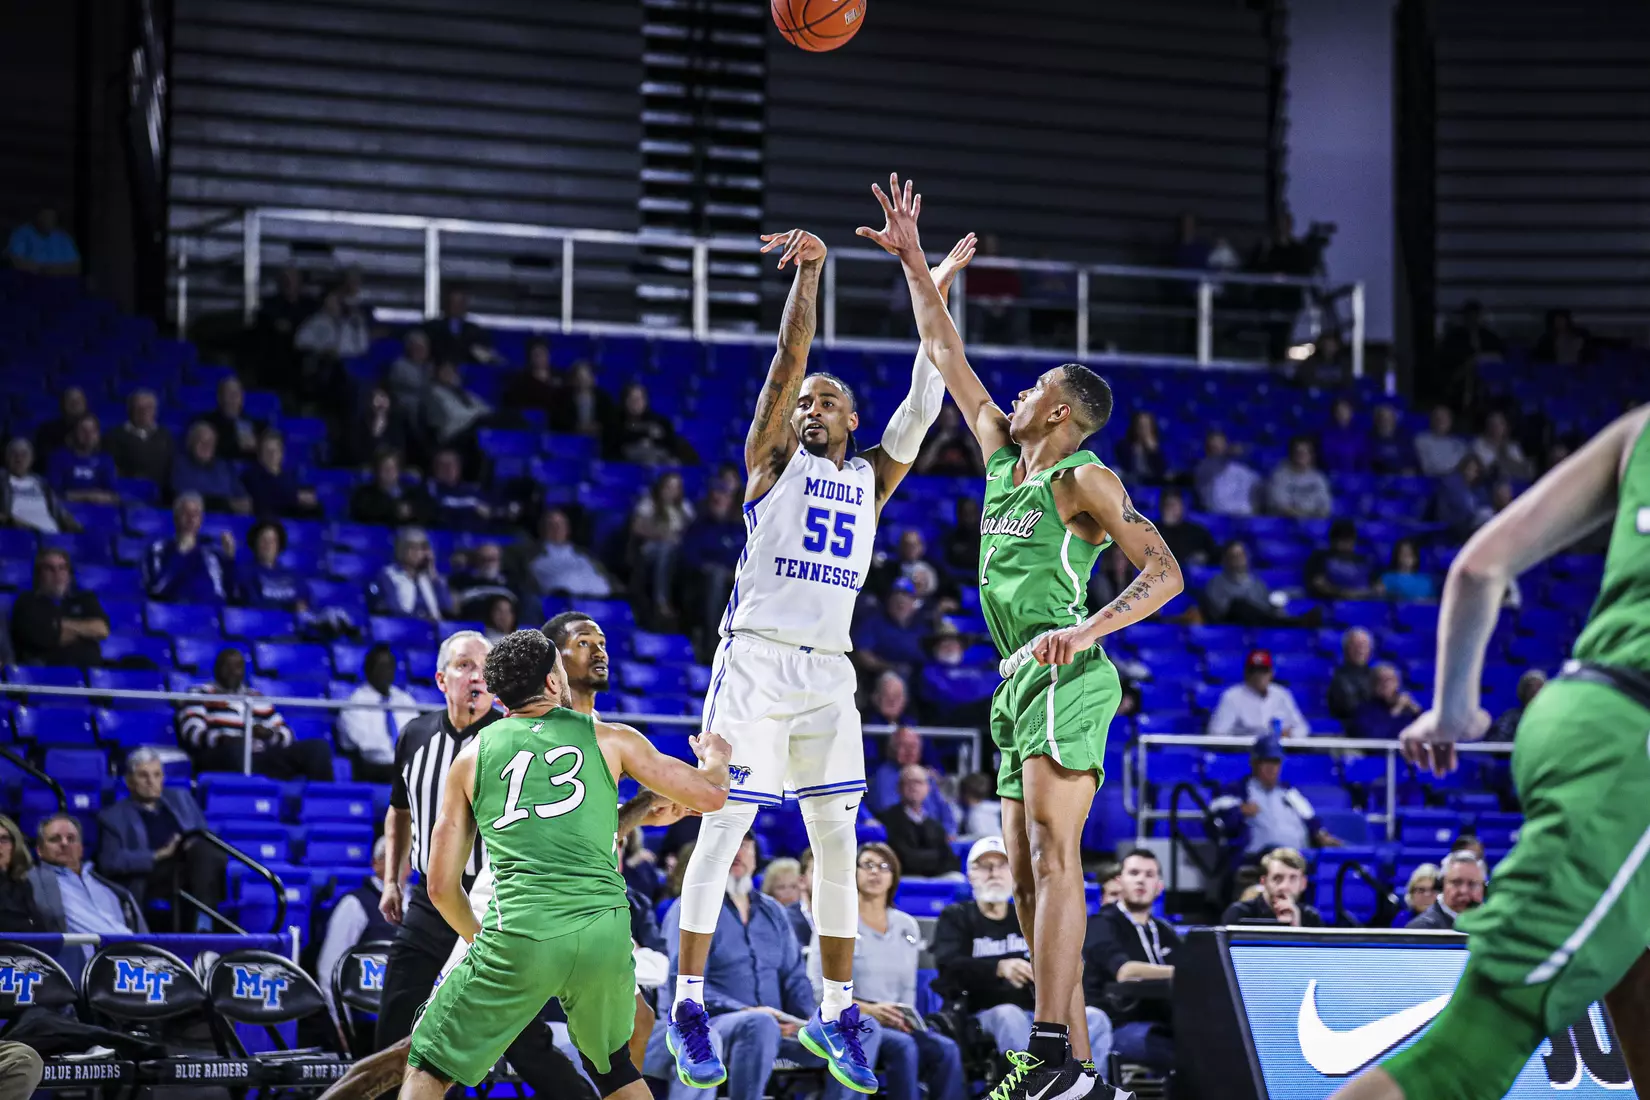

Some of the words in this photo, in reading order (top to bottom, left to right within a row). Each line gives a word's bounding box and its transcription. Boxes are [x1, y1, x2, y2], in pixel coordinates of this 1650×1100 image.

[804, 476, 865, 506] MIDDLE
[802, 505, 857, 559] 55
[980, 504, 1044, 540] arshall
[774, 556, 863, 594] TENNESSE
[492, 744, 586, 830] 13
[113, 959, 174, 1005] MT
[232, 967, 289, 1011] MT
[359, 956, 389, 991] M
[44, 1064, 72, 1080] BLUE
[74, 1063, 121, 1080] RAIDERS
[175, 1063, 202, 1079] BLUE
[203, 1062, 249, 1078] RAIDERS
